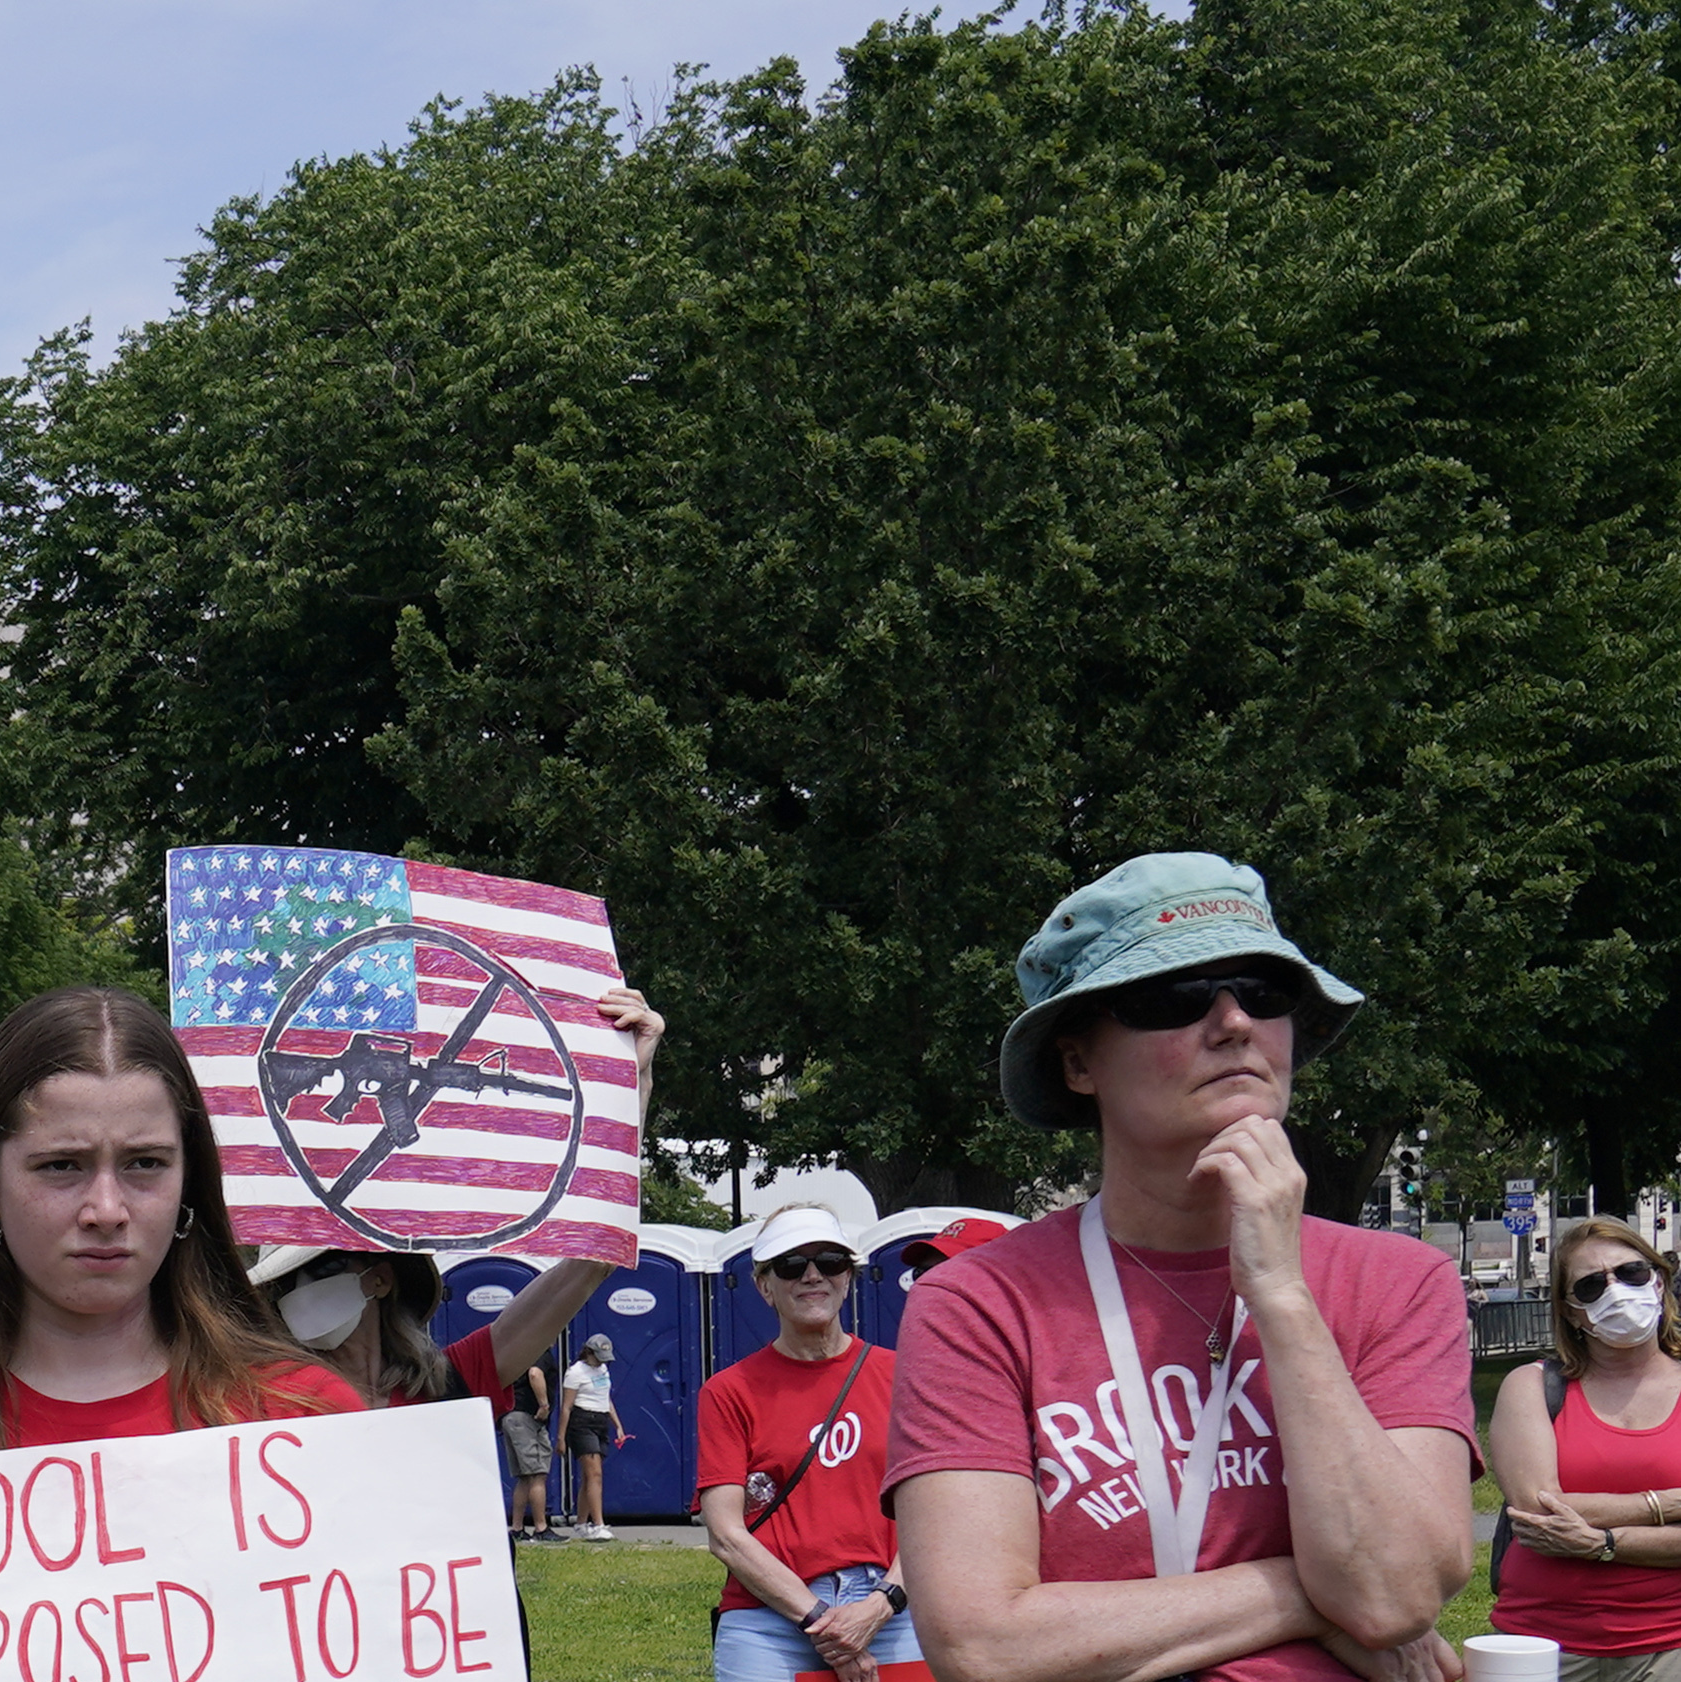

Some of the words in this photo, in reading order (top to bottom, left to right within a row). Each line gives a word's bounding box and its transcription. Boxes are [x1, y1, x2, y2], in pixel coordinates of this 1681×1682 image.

[1512, 1182, 1528, 1190] ALT
[1507, 1216, 1534, 1231] 395
[228, 1431, 313, 1551] IS
[1171, 1446, 1270, 1493] RK
[401, 1556, 492, 1678] BE
